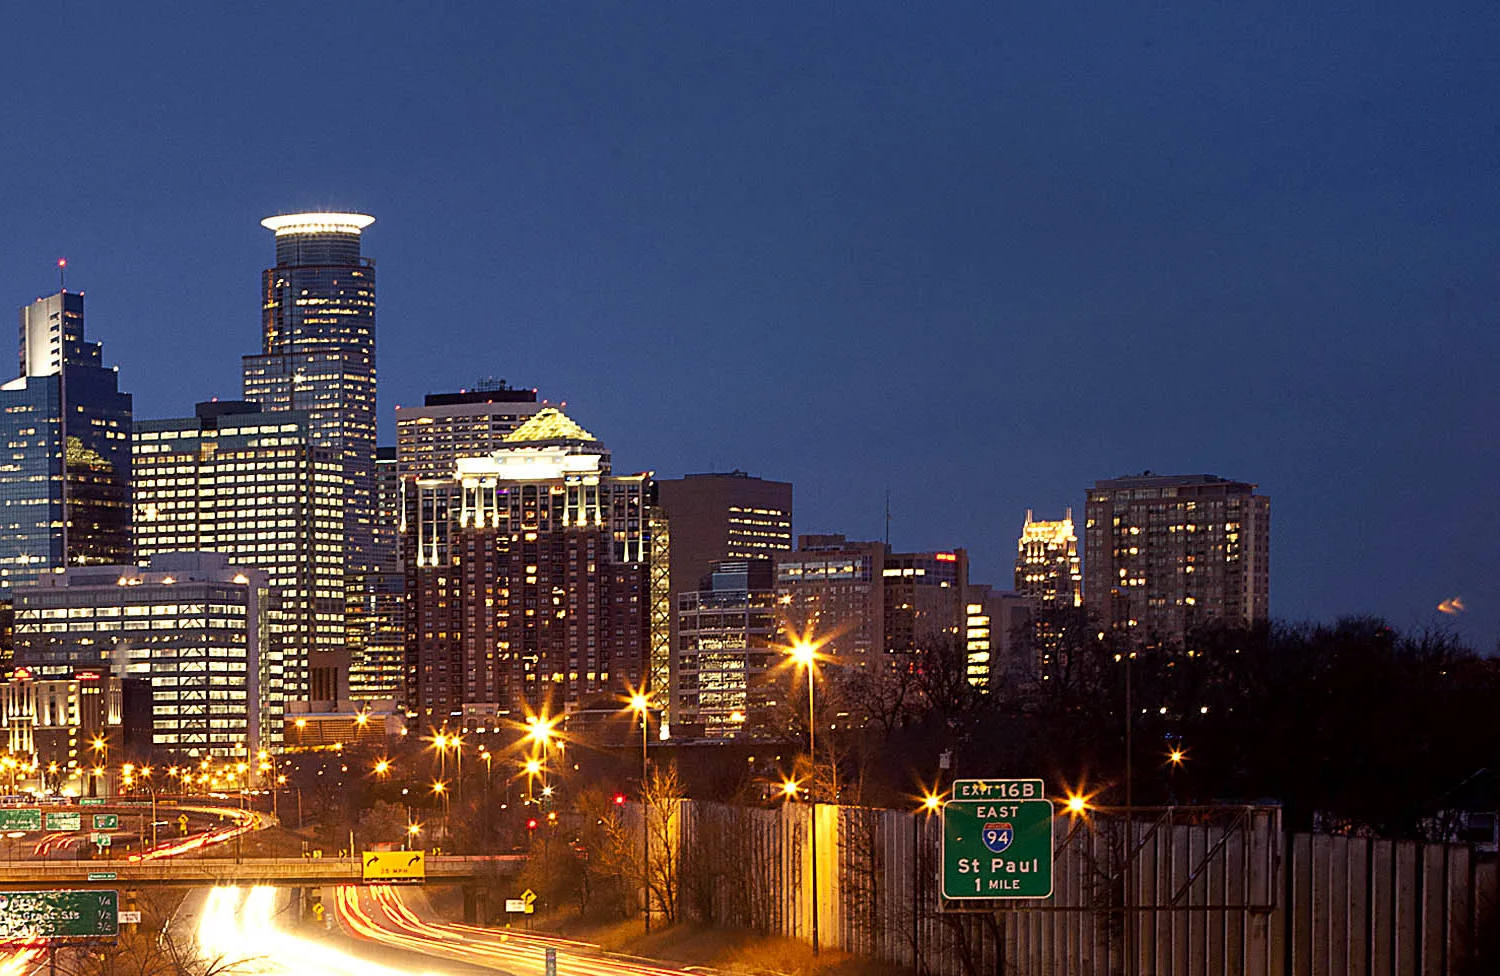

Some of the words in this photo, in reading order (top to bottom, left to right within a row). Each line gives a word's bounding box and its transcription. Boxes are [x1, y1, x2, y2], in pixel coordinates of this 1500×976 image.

[976, 806, 1019, 818] EAST
[987, 831, 1009, 845] 94
[958, 858, 980, 873] St
[991, 858, 1038, 873] Paul
[975, 878, 981, 892] 1
[989, 879, 1020, 889] MILE
